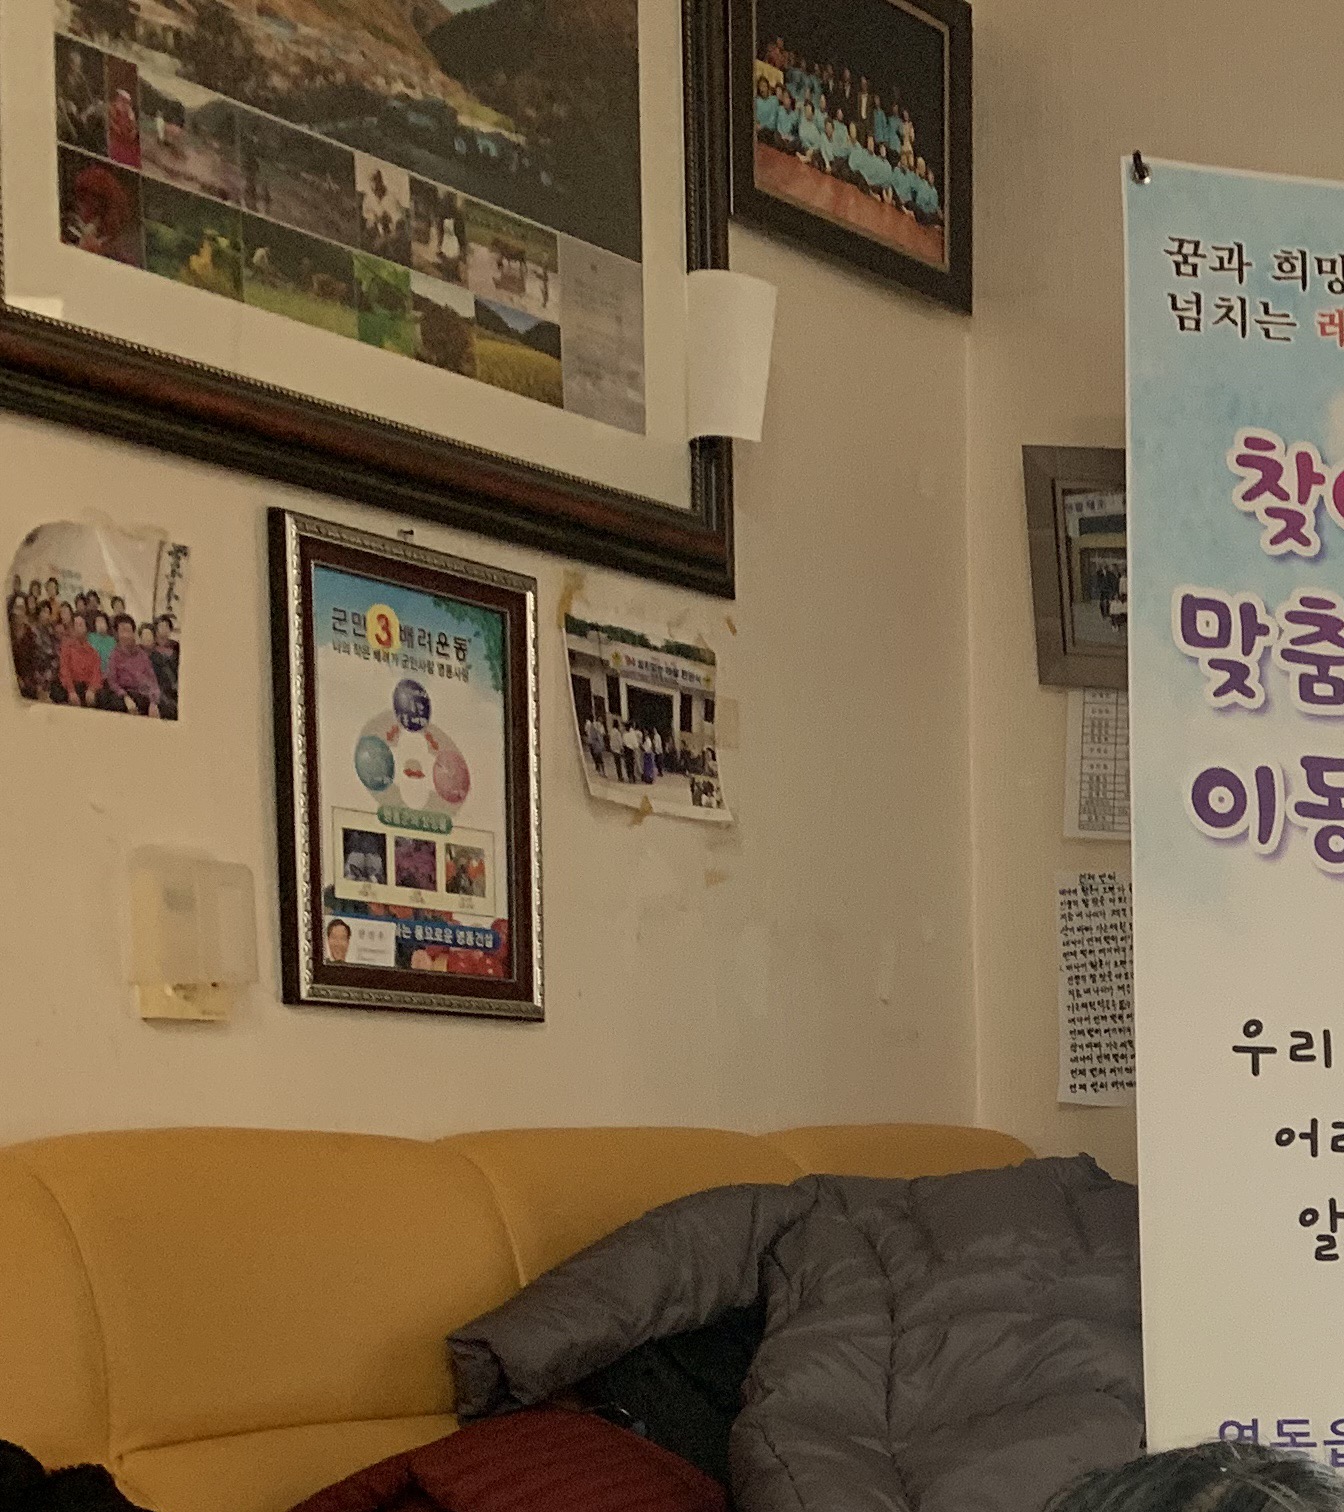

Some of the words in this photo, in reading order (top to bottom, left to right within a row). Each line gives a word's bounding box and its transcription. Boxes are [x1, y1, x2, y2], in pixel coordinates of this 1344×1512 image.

[1163, 235, 1253, 285] 꿈과
[1167, 291, 1297, 342] 넘치는
[1231, 1018, 1333, 1076] 우리
